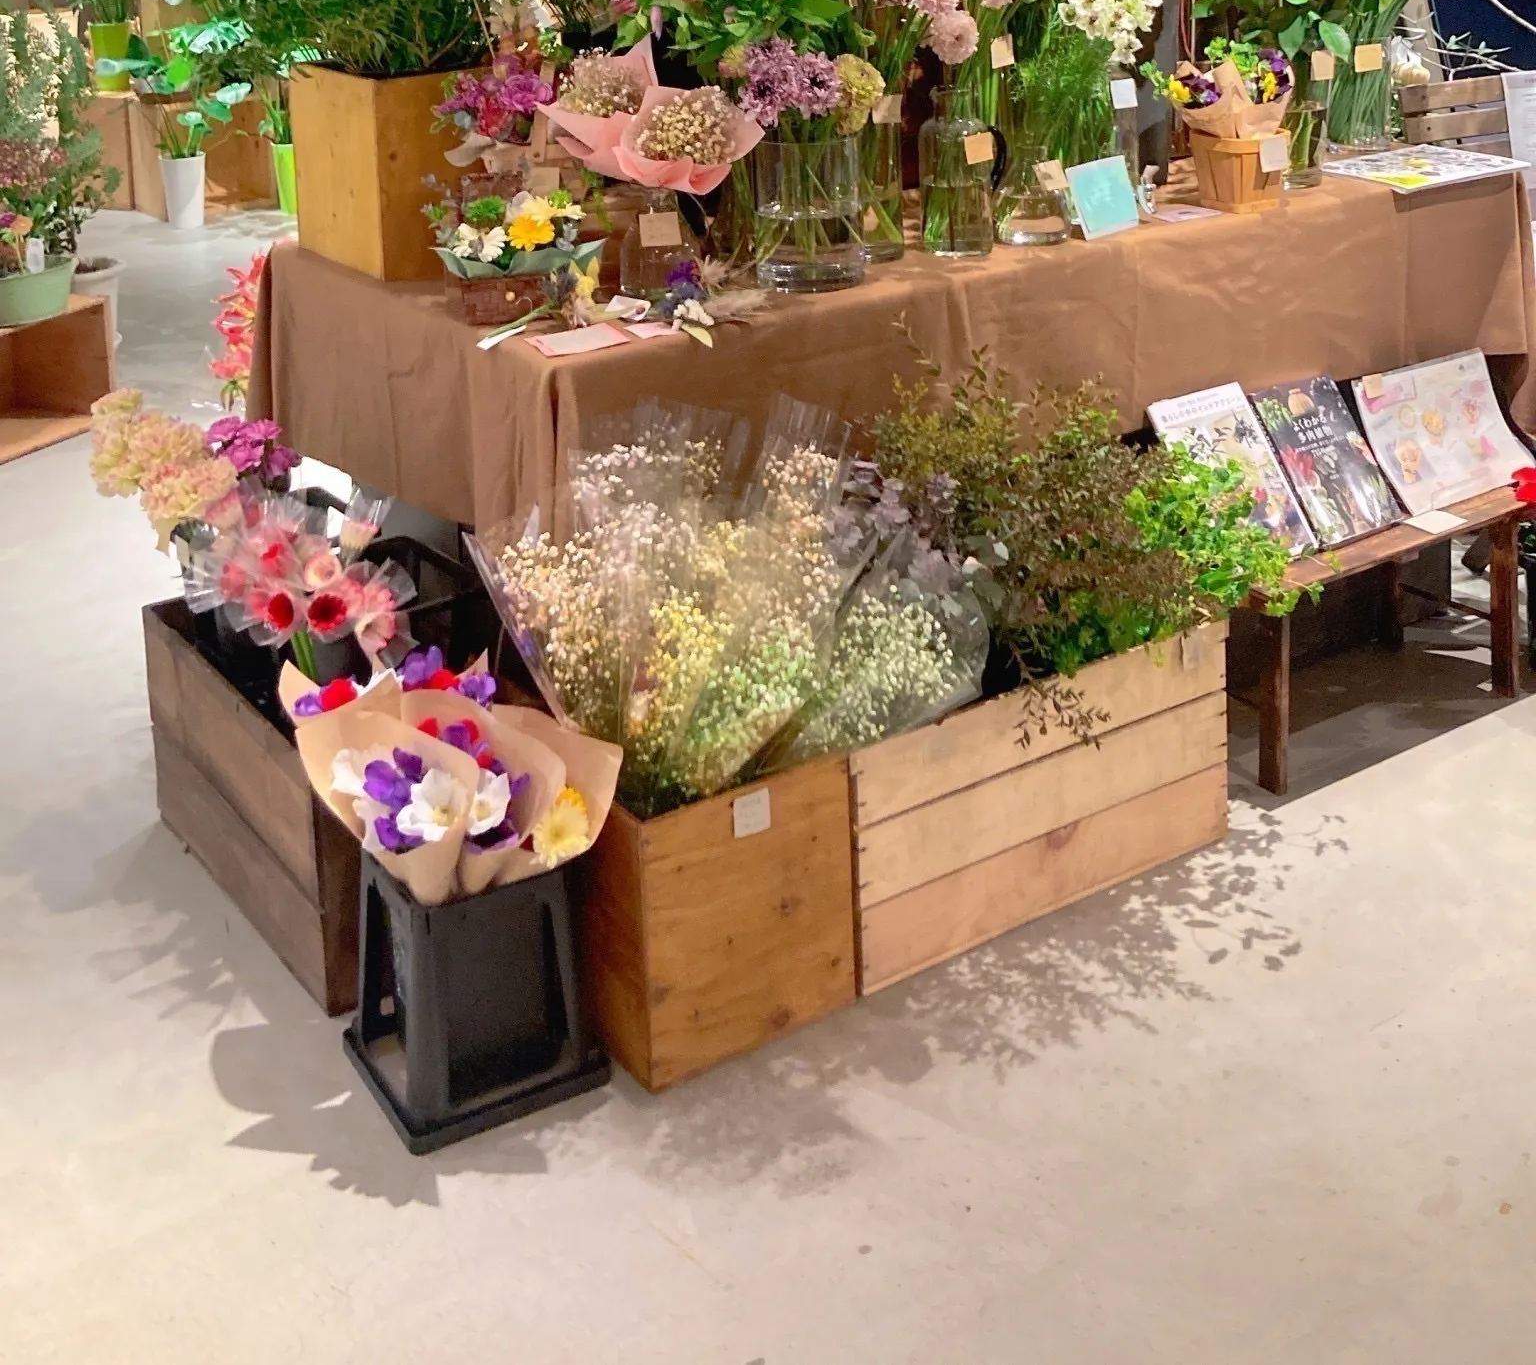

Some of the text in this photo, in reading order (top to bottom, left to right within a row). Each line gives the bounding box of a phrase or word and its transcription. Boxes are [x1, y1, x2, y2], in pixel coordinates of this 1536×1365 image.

[1291, 414, 1328, 432] よくわかる
[1298, 424, 1334, 443] 多肉植物
